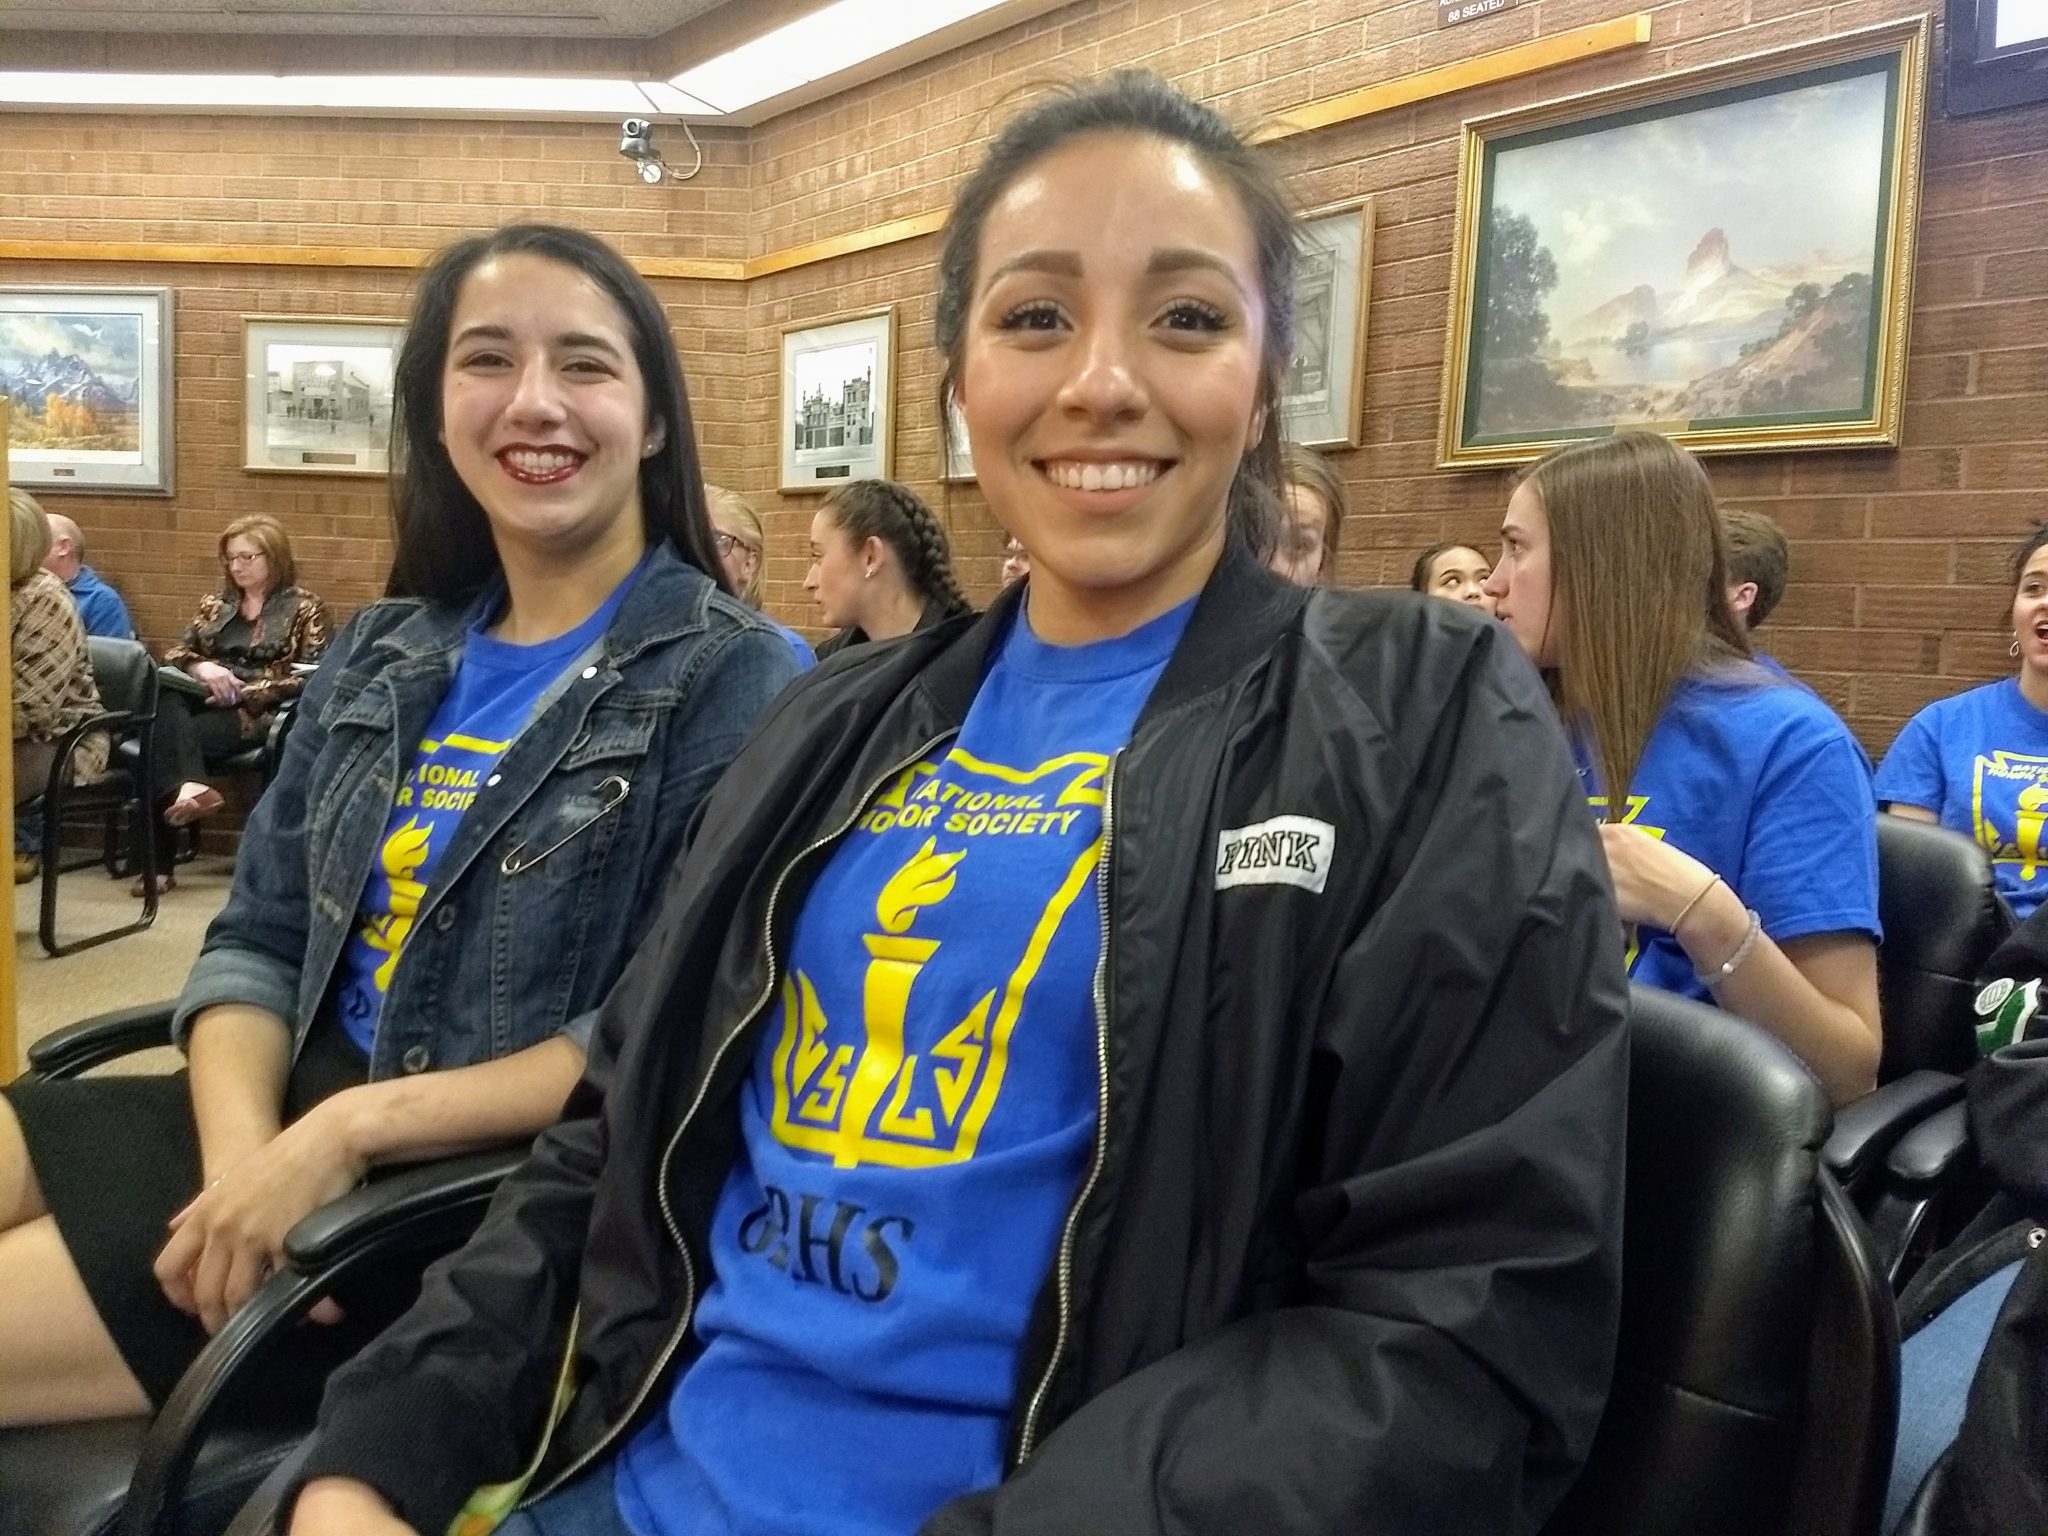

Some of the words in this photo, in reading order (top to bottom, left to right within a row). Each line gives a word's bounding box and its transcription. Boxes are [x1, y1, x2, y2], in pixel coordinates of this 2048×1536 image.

[1448, 9, 1460, 23] 88
[1462, 0, 1505, 17] SEATED
[911, 779, 1046, 811] ATIONAL
[944, 810, 1082, 836] SOCIETY
[1218, 830, 1320, 874] PINK
